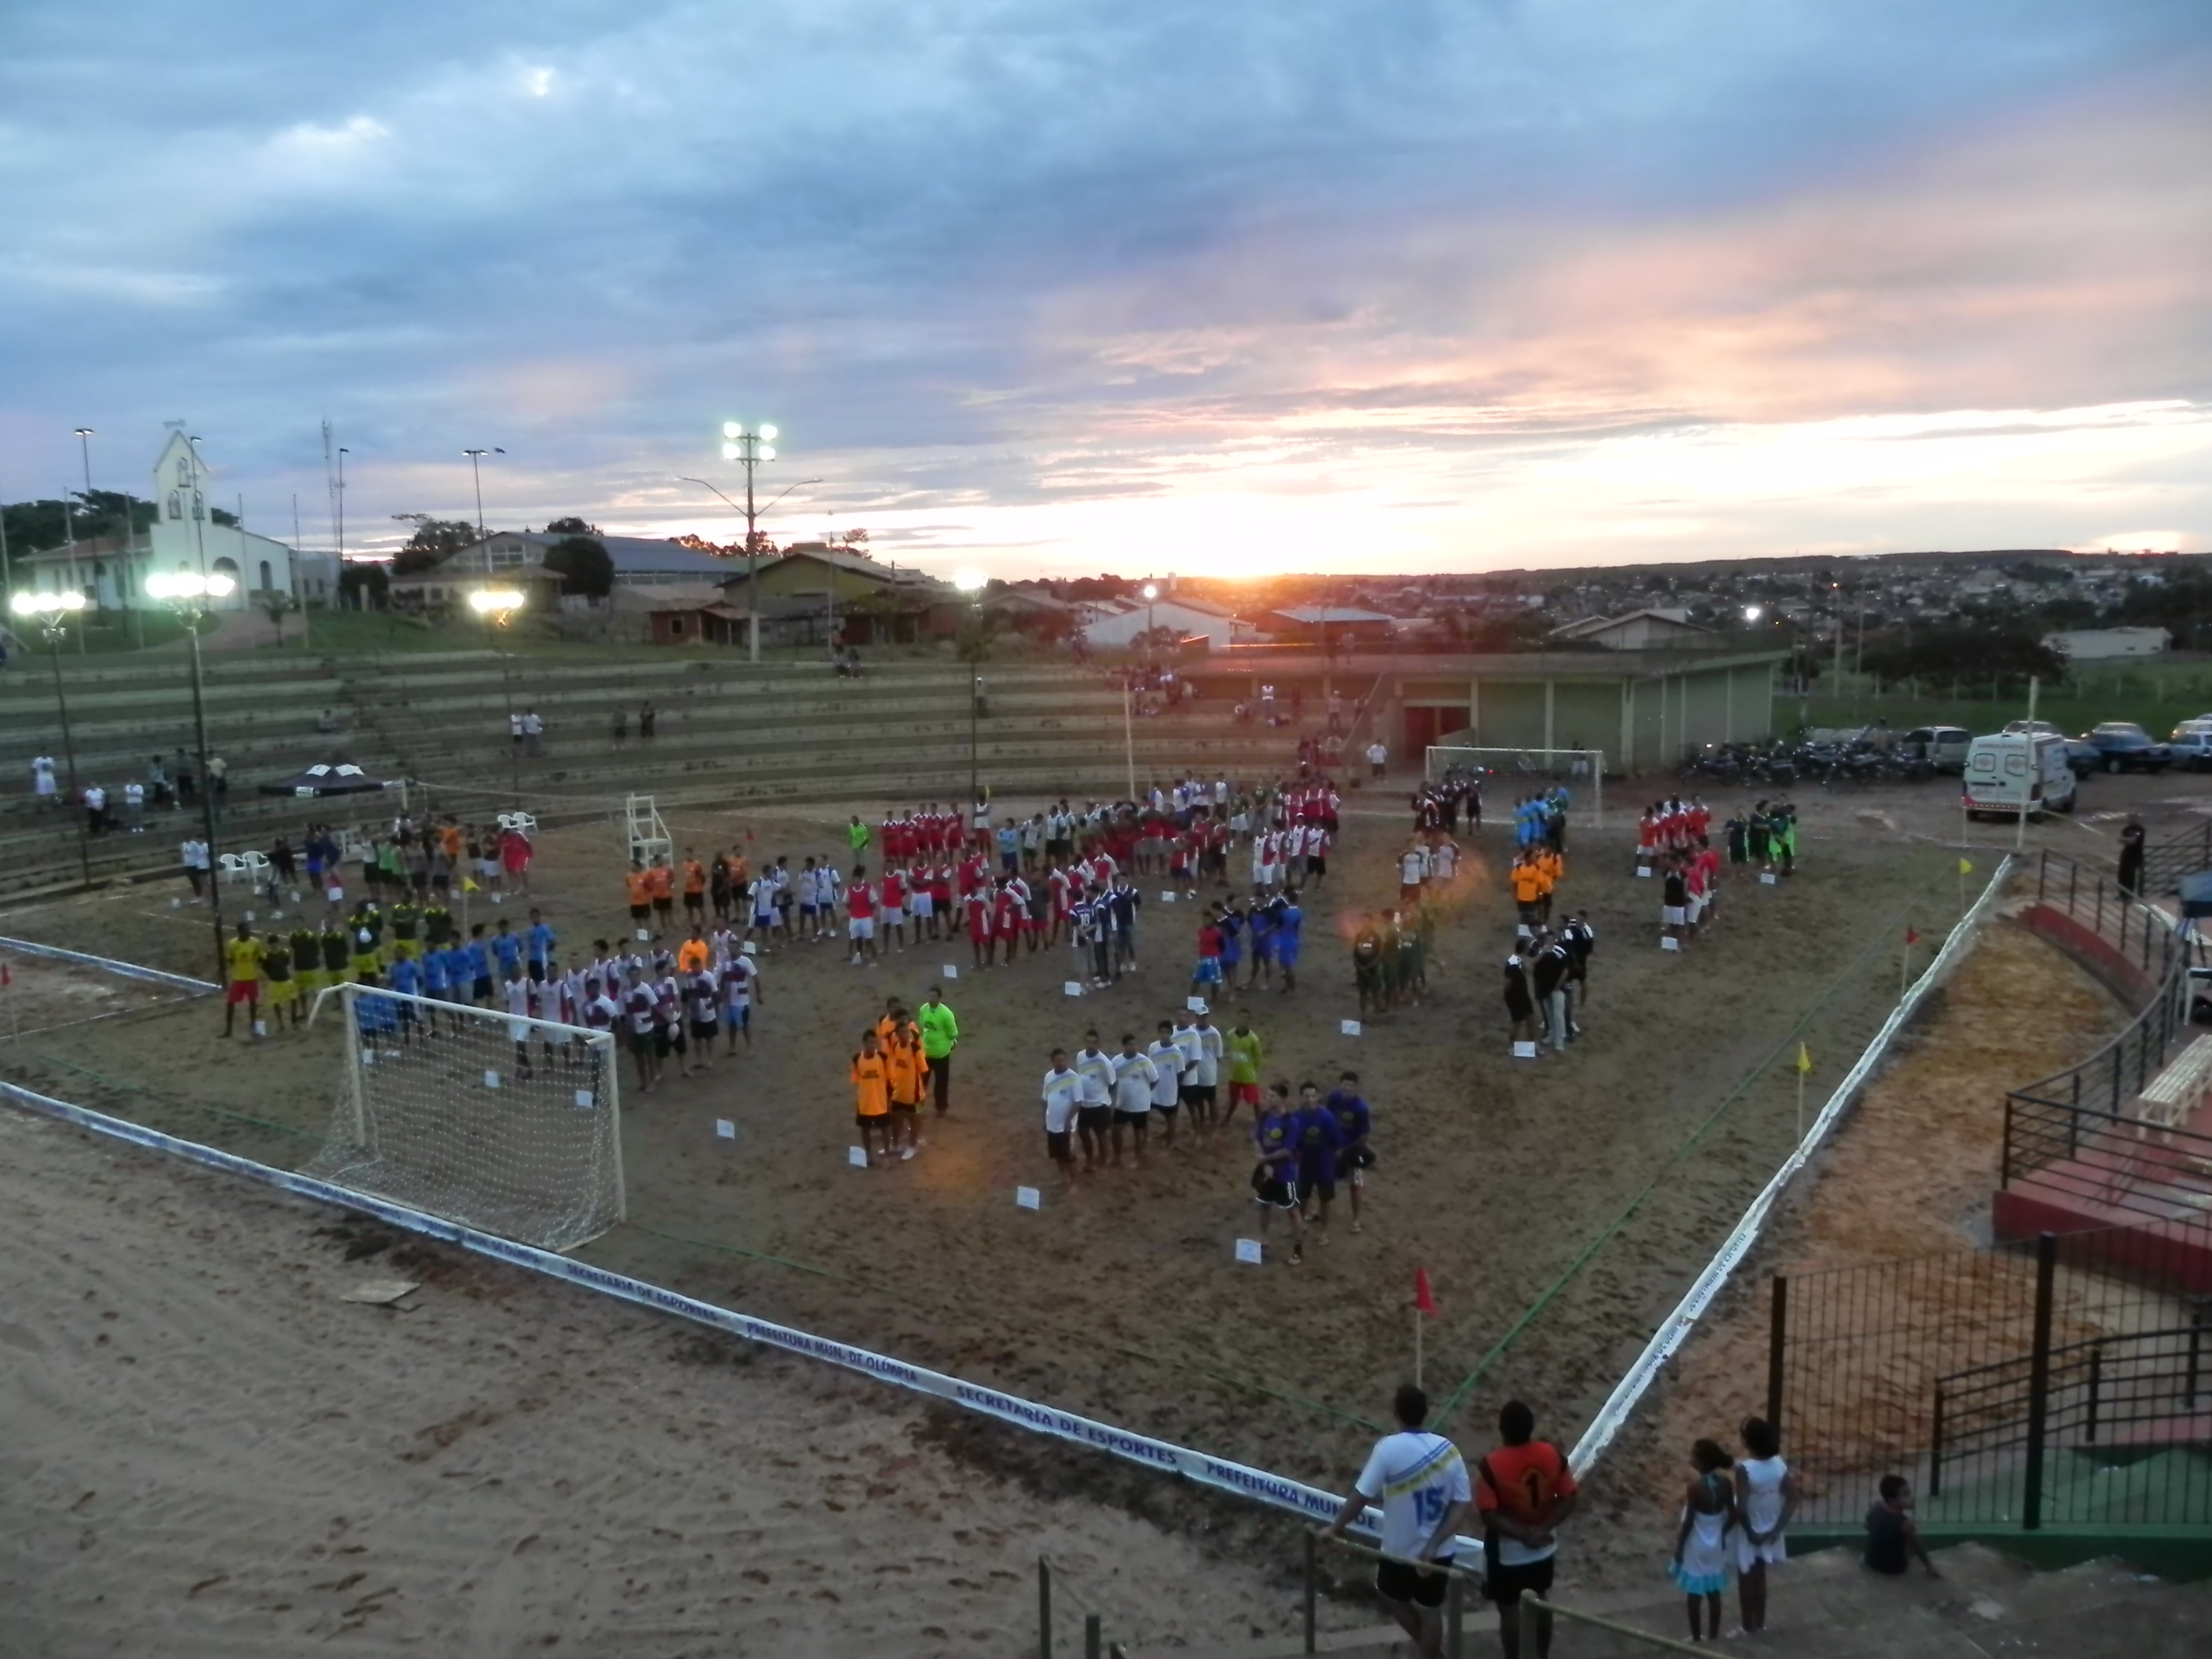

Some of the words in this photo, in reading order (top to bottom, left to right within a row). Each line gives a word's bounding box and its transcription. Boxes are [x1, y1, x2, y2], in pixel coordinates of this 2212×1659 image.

[637, 1285, 653, 1298] DE
[657, 1292, 718, 1321] ESPORTES
[747, 1322, 811, 1350] PREFEITURA
[814, 1341, 845, 1359] MUN.
[850, 1350, 863, 1364] DE
[866, 1356, 918, 1382] OLÍMPIA
[956, 1384, 1054, 1427] SECRETARIA
[1060, 1418, 1082, 1436] DE
[1088, 1429, 1178, 1465] ESPORTES
[1207, 1461, 1299, 1504] PREFEITURA
[1524, 1471, 1542, 1510] 1
[1412, 1486, 1446, 1528] 15
